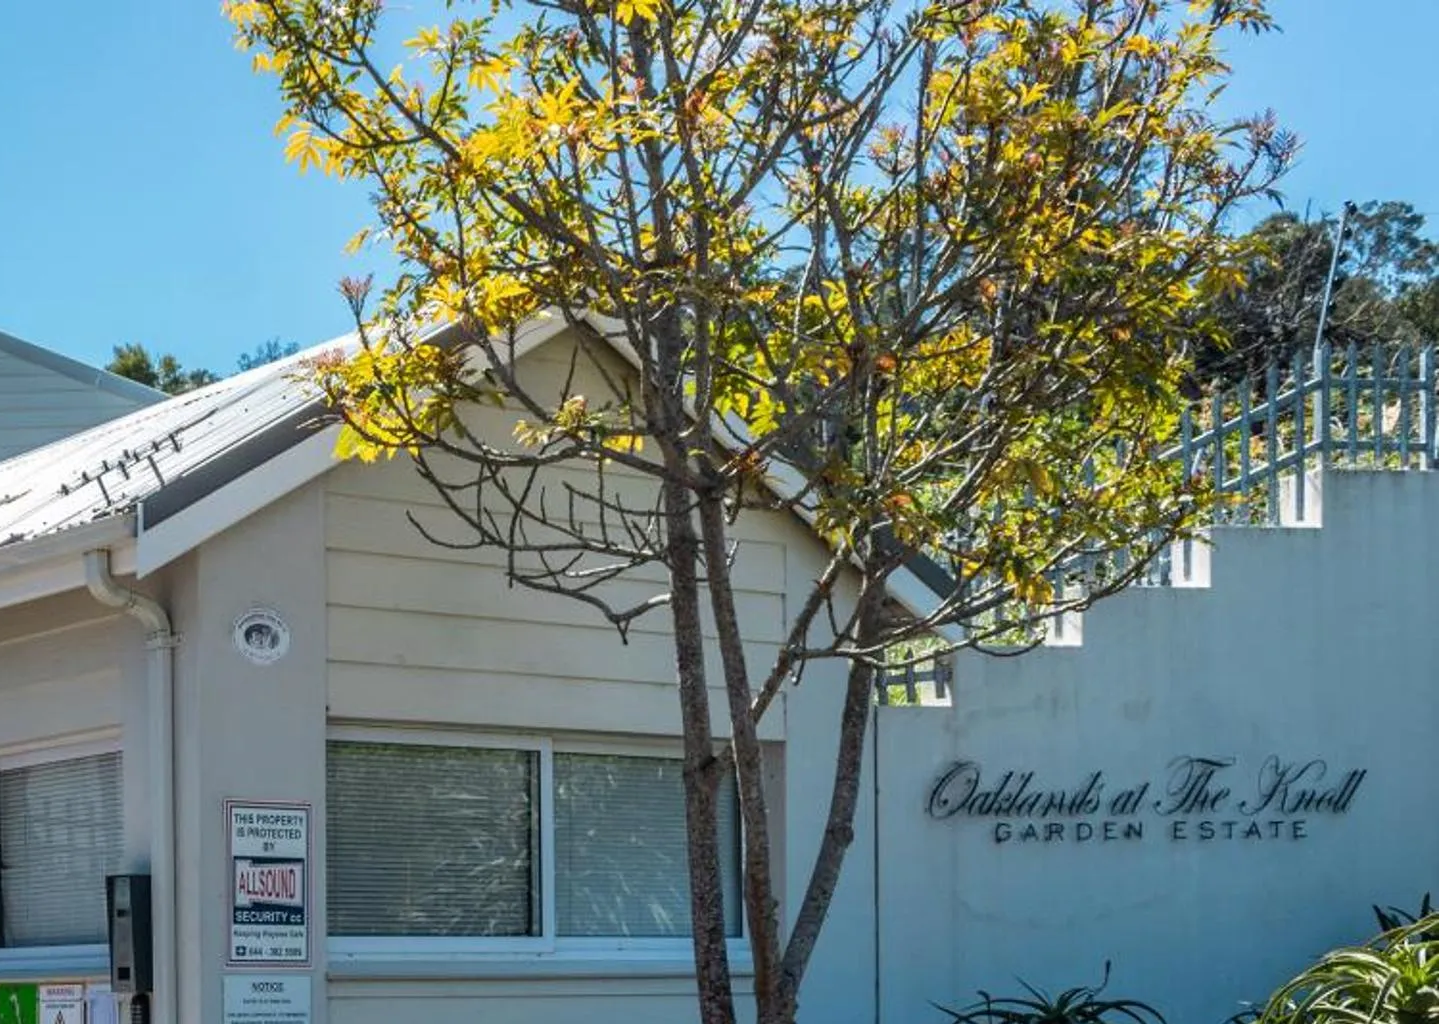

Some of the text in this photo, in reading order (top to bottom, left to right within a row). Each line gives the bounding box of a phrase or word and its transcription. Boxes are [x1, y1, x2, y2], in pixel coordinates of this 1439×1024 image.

[929, 754, 1368, 820] Oaklands at The Knoll
[234, 813, 304, 827] THIS PROPERTY
[237, 827, 302, 840] IS PROTECTED
[994, 819, 1308, 843] GARDEN ESTATE
[263, 841, 275, 852] BY
[239, 868, 296, 900] ALLSOUND
[235, 910, 288, 923] SECURITY
